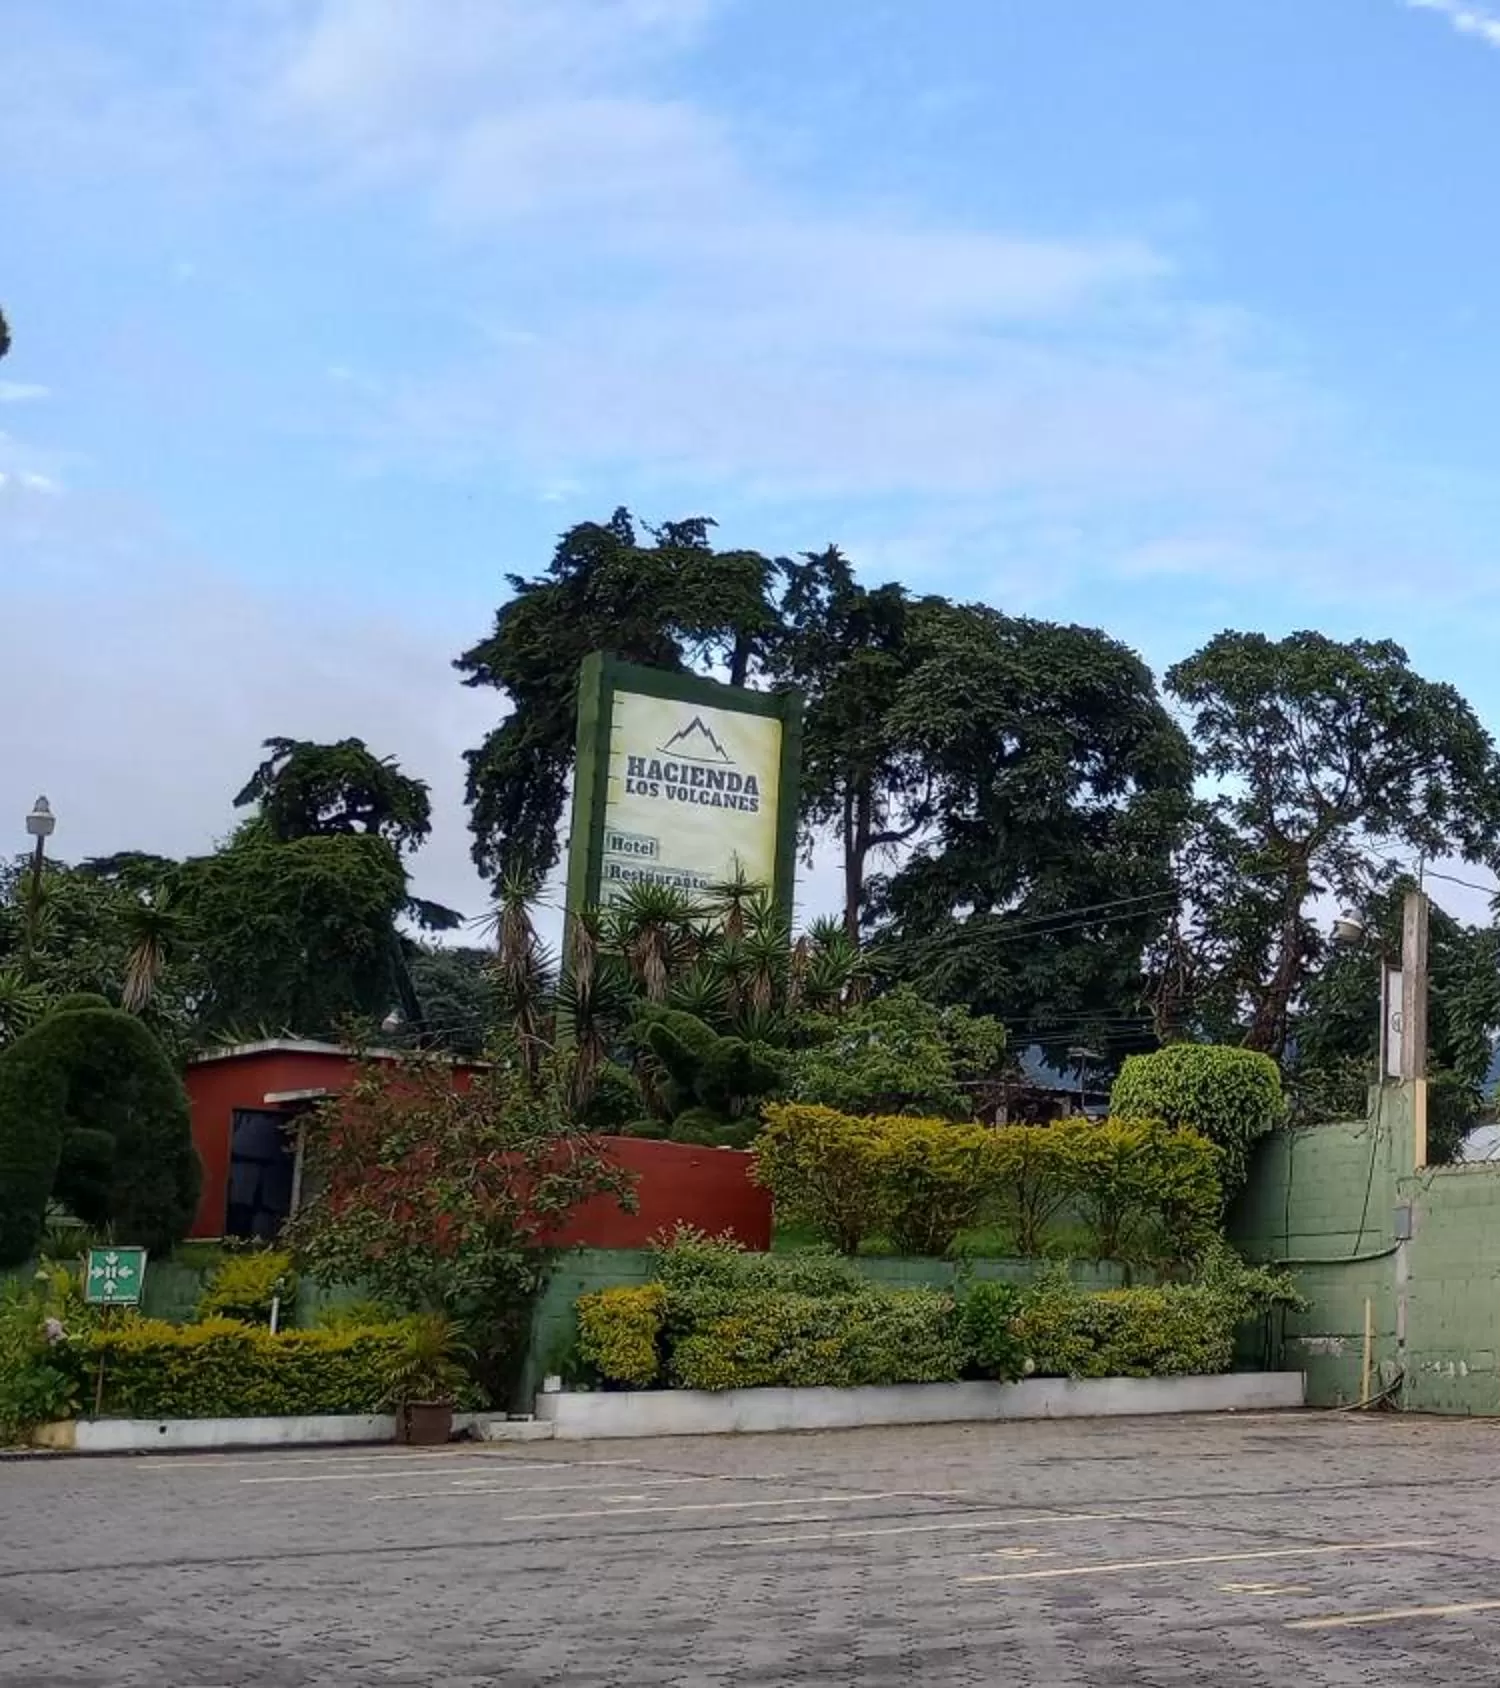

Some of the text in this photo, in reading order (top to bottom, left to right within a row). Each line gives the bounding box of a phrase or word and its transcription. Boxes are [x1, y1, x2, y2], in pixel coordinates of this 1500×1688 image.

[627, 756, 760, 795] HACIENDA
[625, 778, 760, 813] LOS VOLCANES
[611, 836, 655, 855] Hotel
